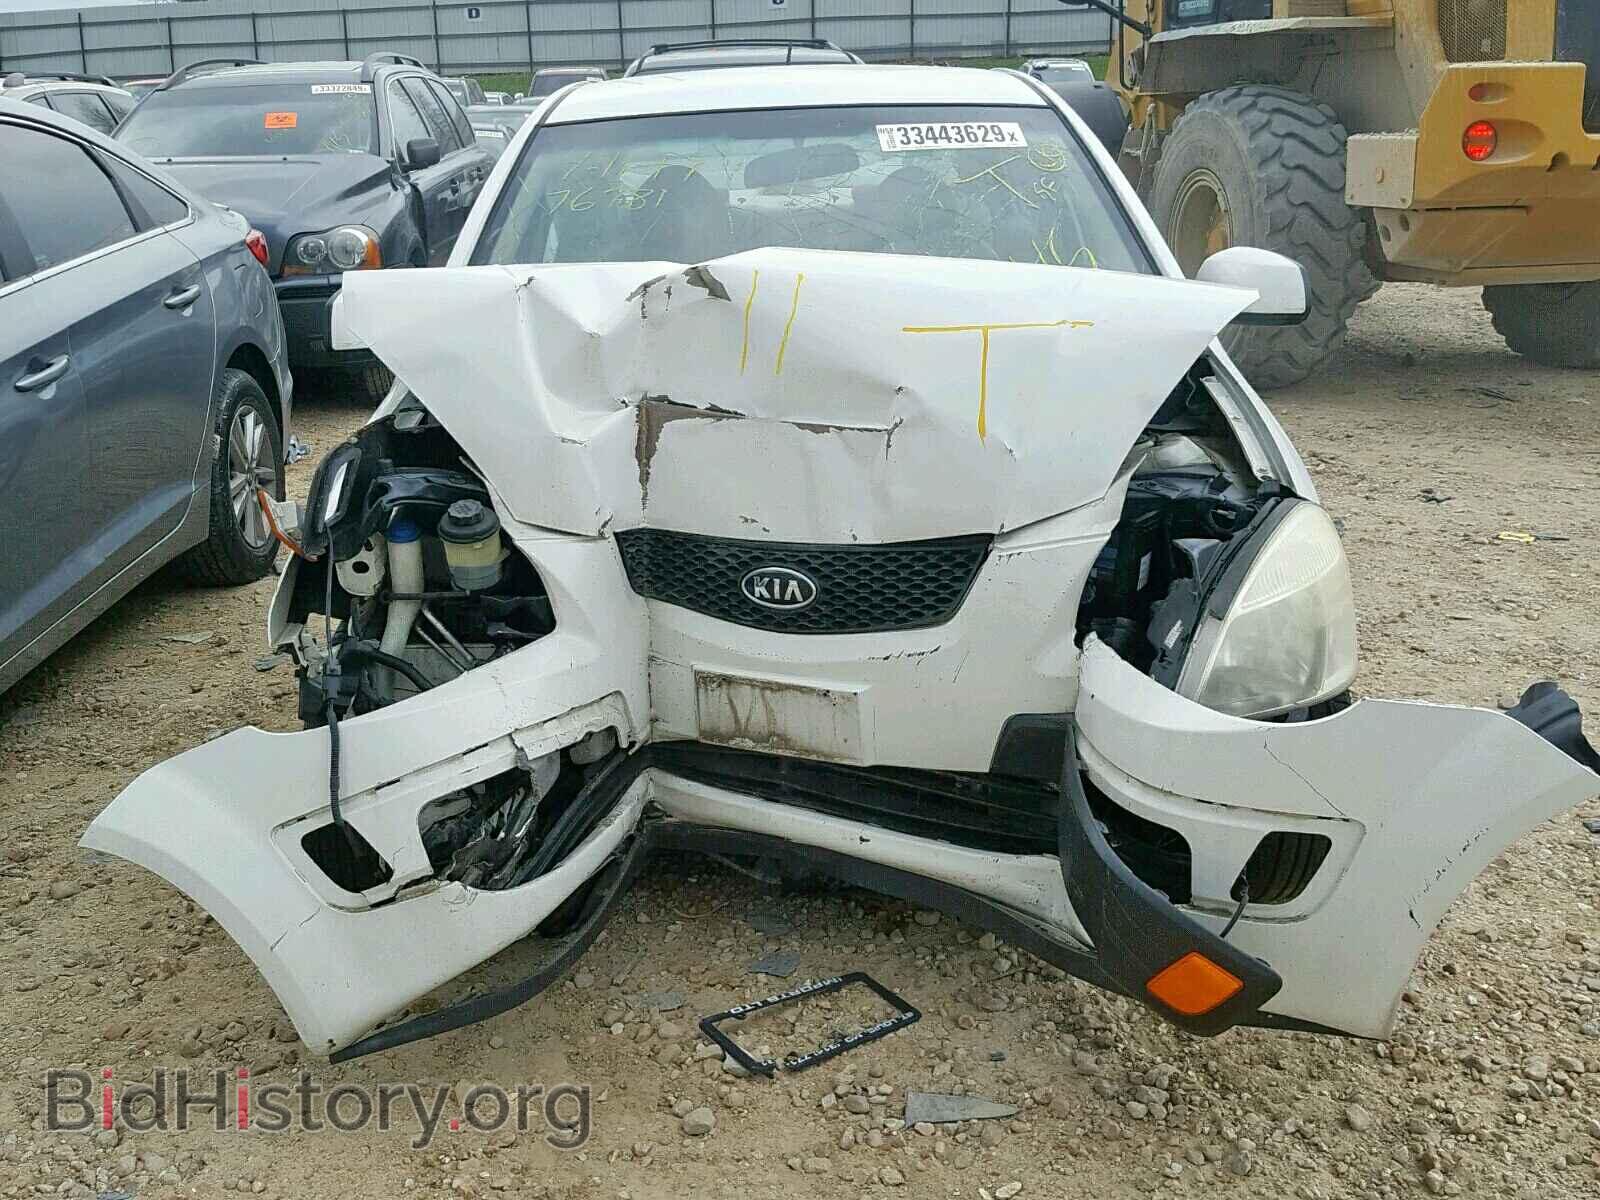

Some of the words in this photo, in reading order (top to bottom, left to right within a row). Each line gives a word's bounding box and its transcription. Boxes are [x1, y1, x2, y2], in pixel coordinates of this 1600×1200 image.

[468, 7, 481, 19] D
[896, 123, 1006, 146] 33443629
[902, 320, 1096, 445] T
[753, 575, 804, 602] KIA
[766, 976, 843, 1003] IMPORTS
